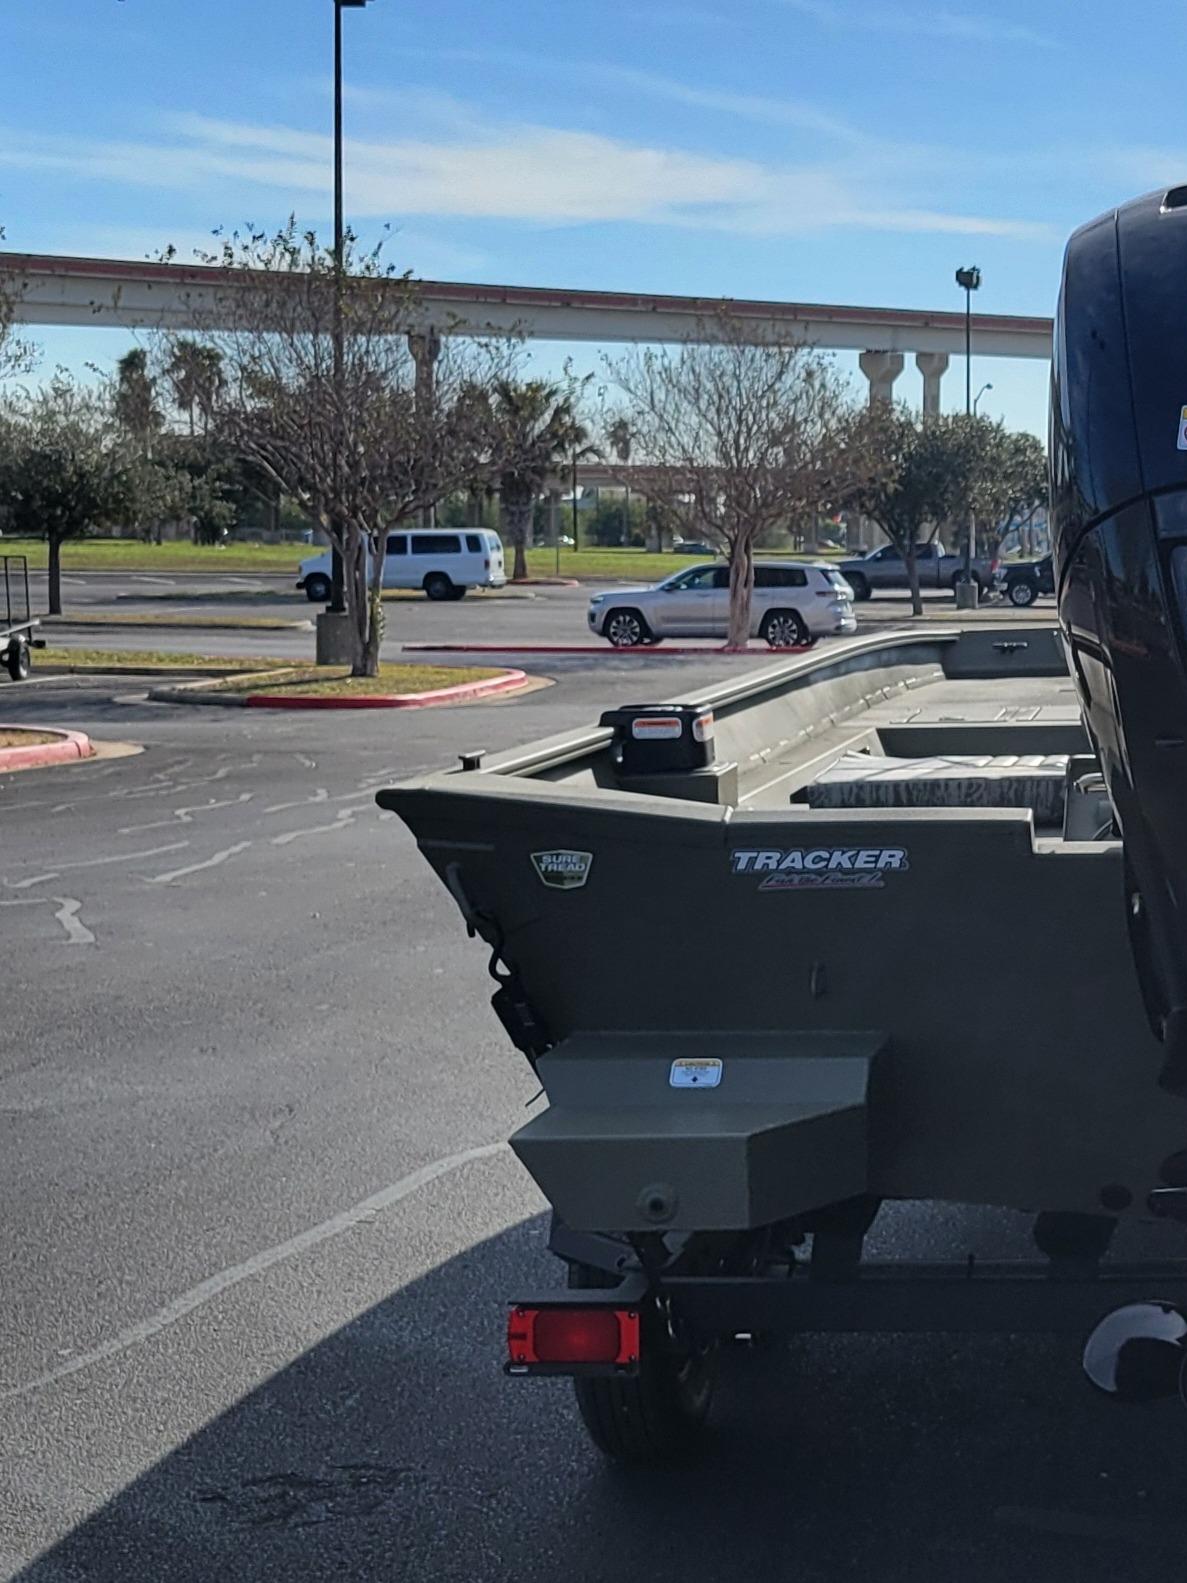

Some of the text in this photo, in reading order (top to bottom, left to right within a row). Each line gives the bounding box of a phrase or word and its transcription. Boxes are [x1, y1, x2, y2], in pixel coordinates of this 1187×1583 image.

[541, 855, 580, 863] SURE
[734, 850, 905, 870] TRACKER
[539, 863, 586, 872] TREAD
